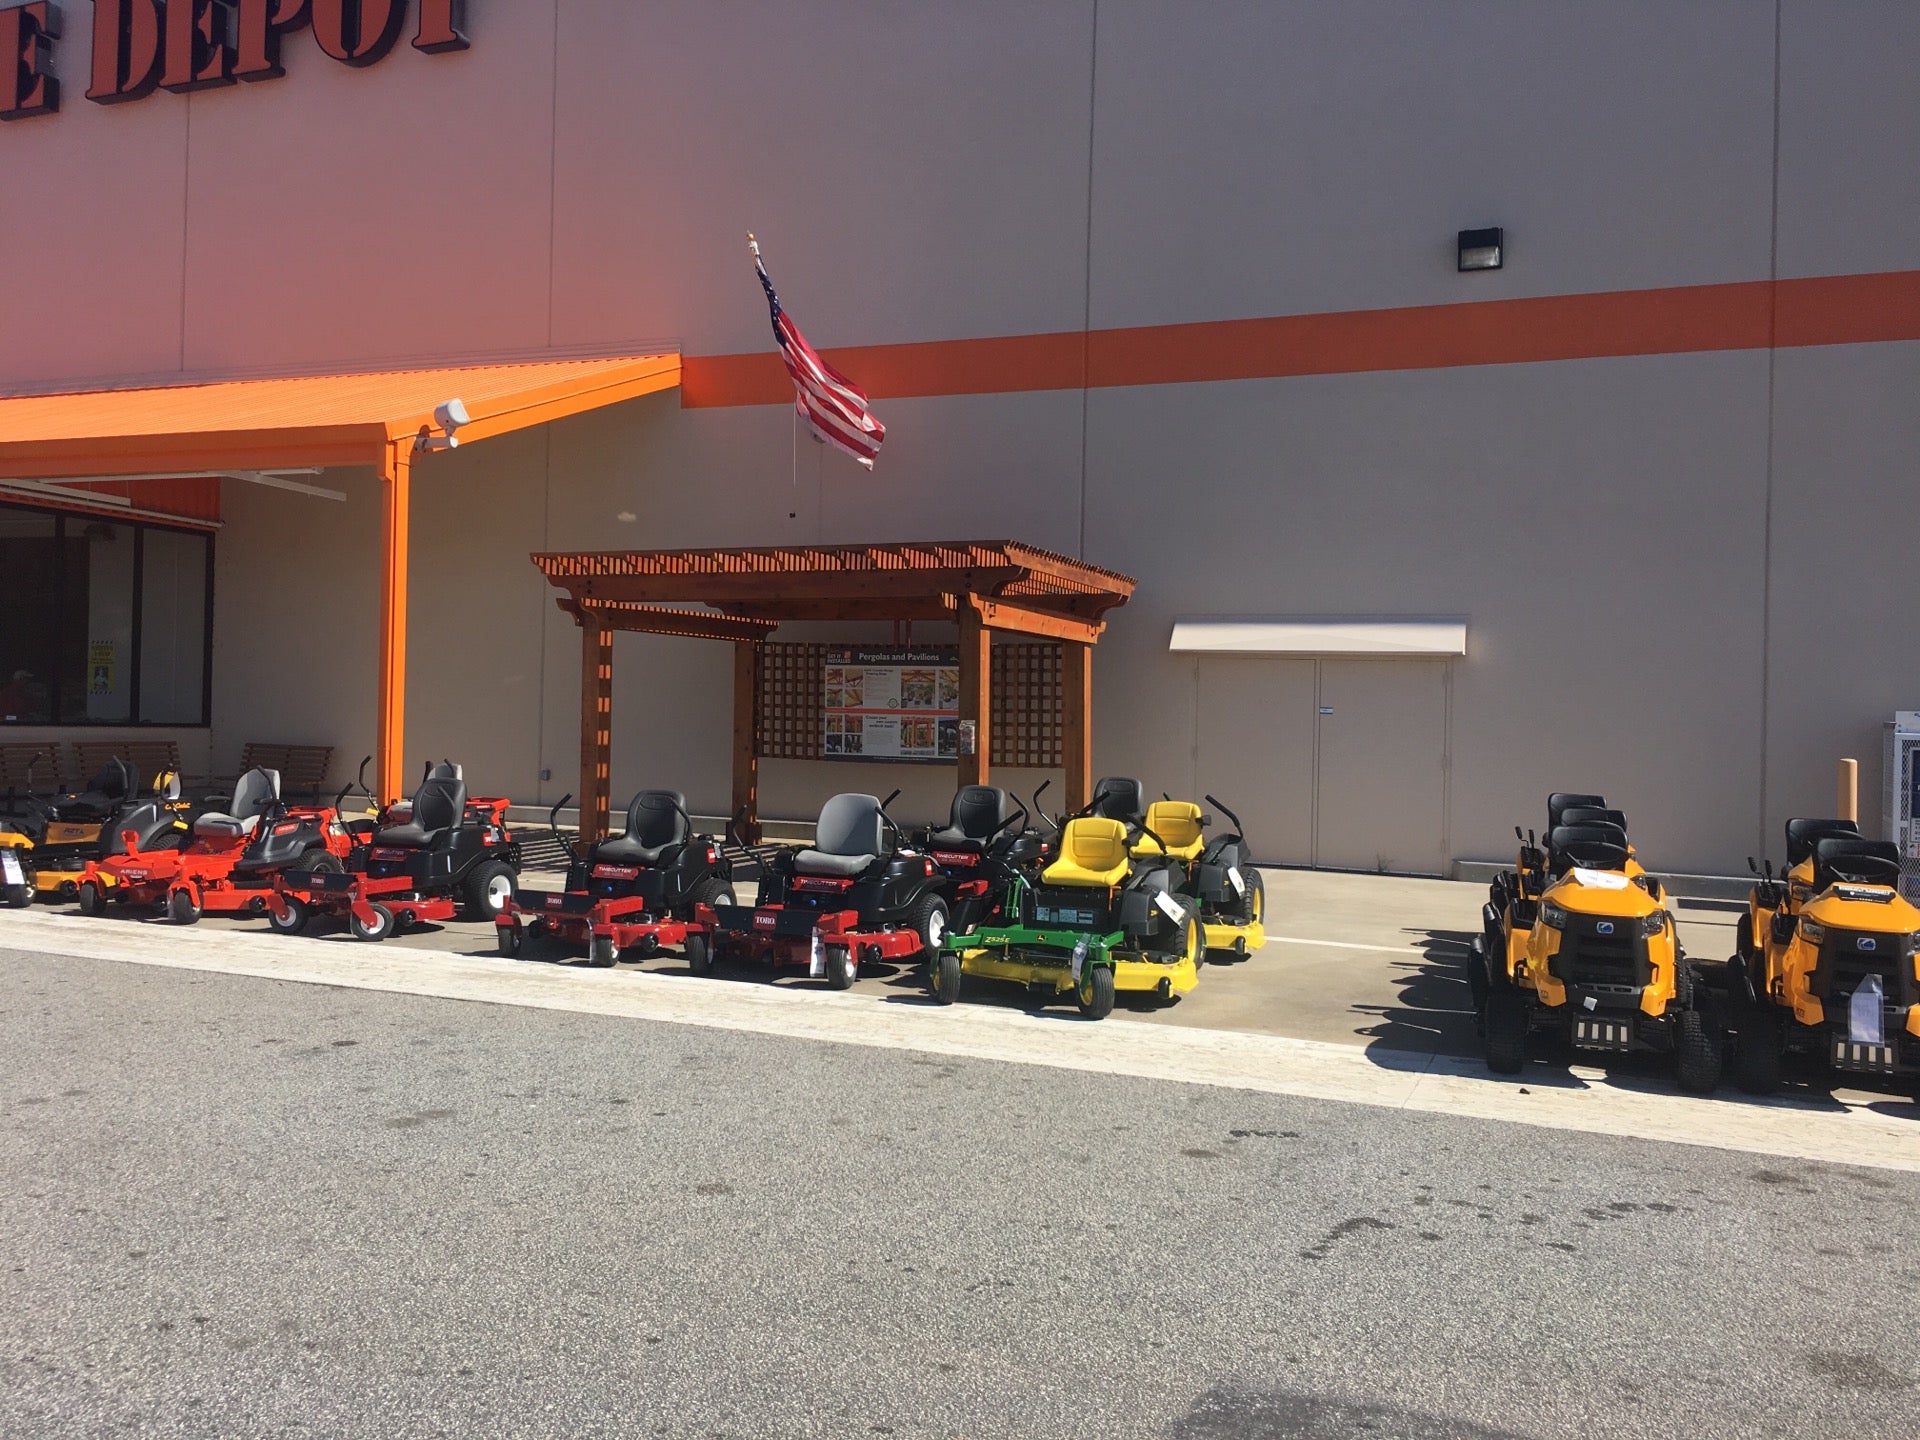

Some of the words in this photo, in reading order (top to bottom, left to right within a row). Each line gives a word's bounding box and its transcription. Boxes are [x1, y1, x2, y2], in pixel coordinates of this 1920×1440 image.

[859, 652, 890, 662] Pergolas
[891, 653, 905, 661] and
[907, 653, 940, 661] Pavilions
[754, 916, 776, 925] TORO
